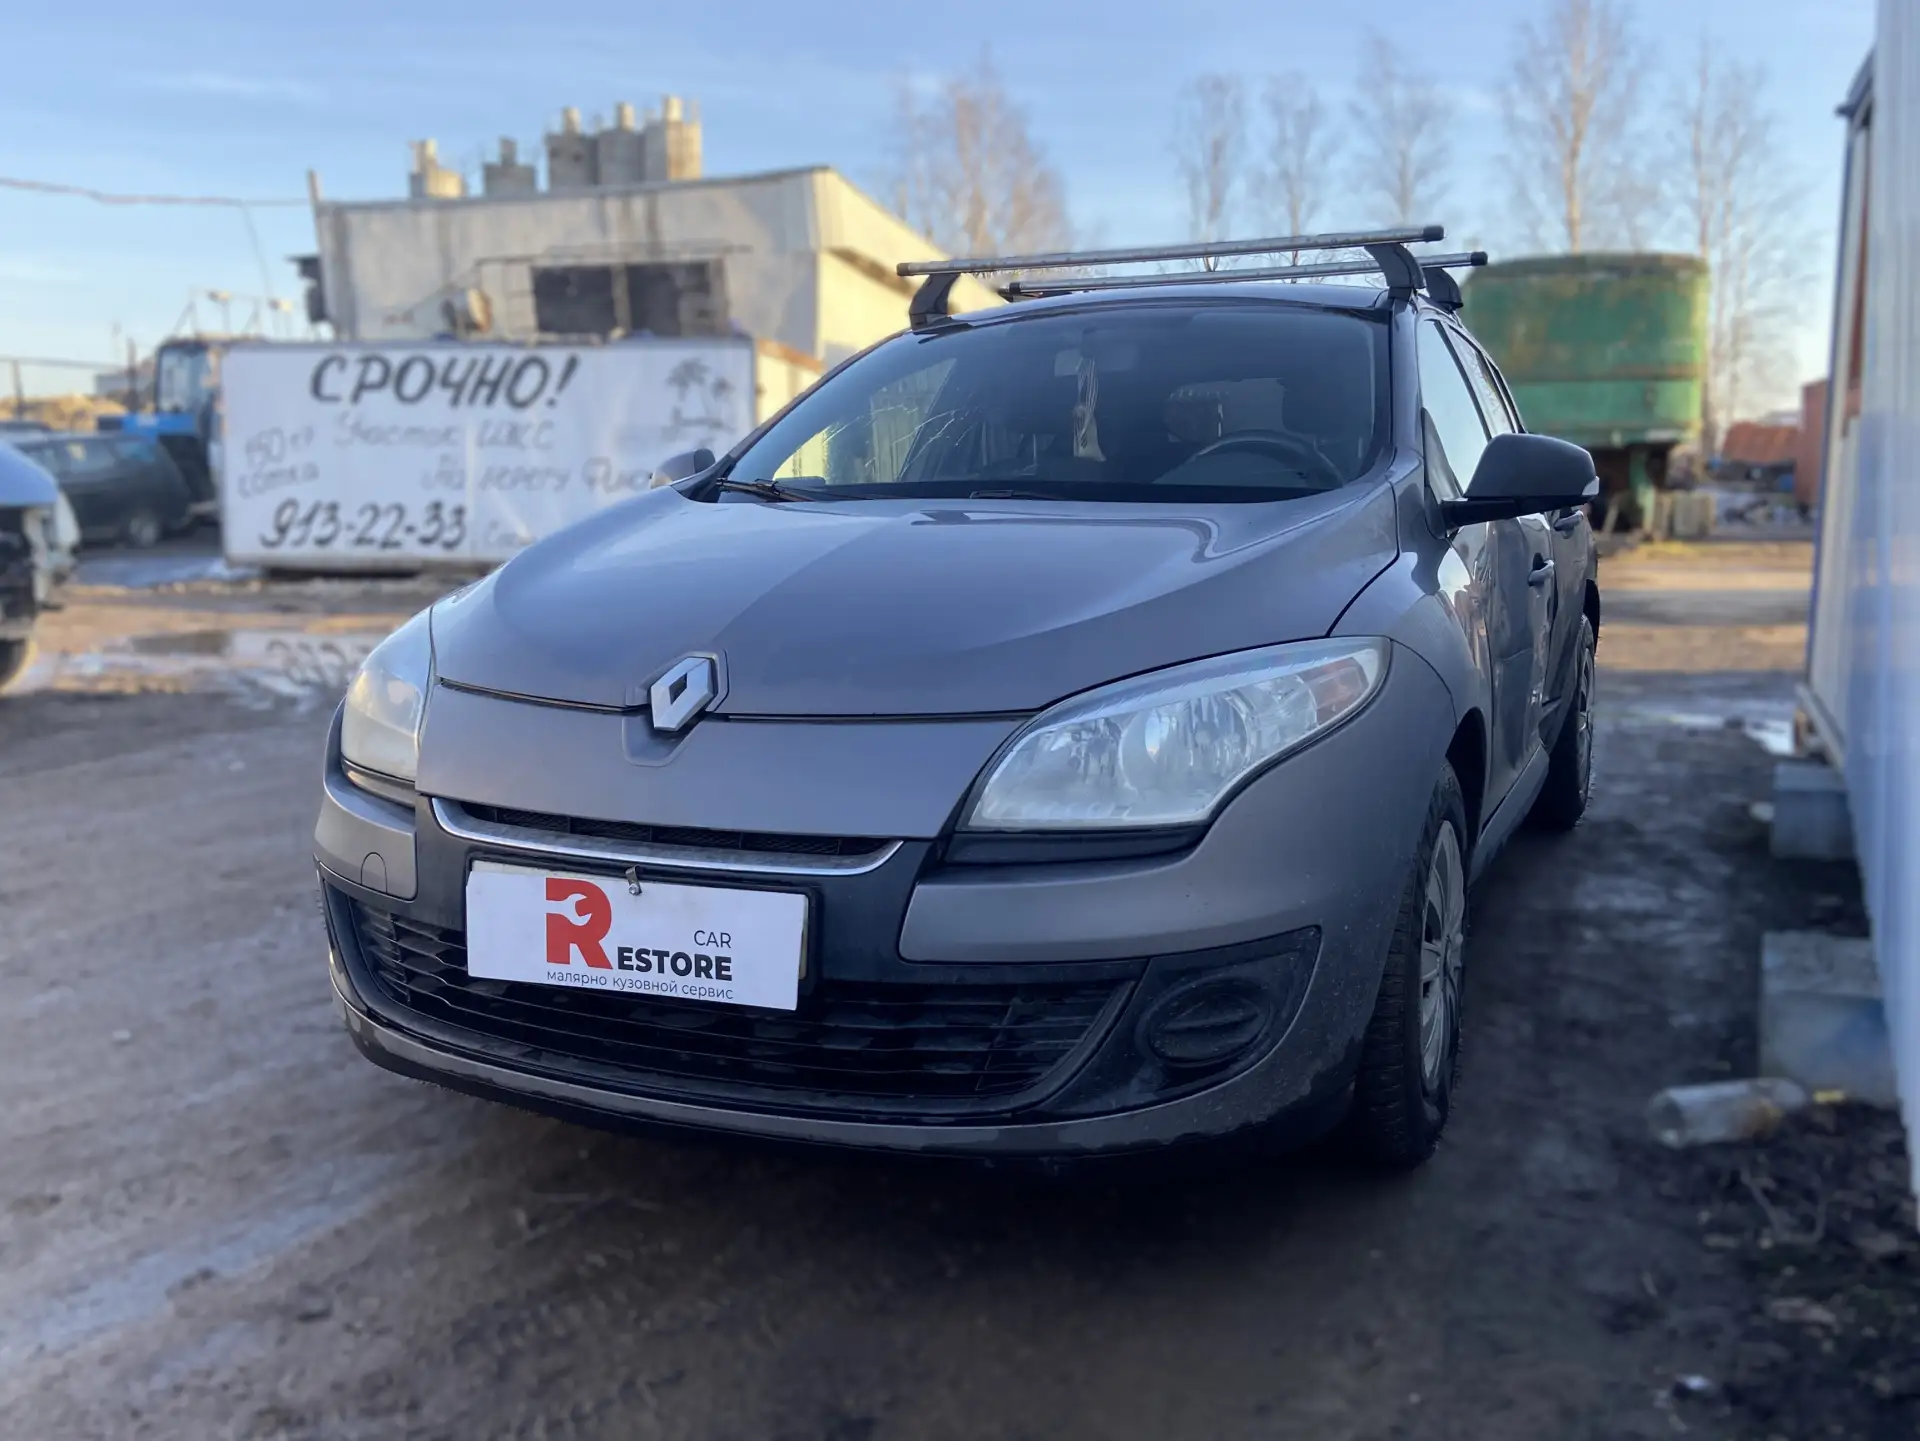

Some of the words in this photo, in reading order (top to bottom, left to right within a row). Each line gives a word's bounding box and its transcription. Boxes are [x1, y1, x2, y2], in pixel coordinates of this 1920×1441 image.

[310, 353, 580, 409] СРОЧНО!
[259, 497, 467, 551] 913-22-33
[693, 929, 732, 949] CAR
[546, 970, 608, 987] малярно
[612, 976, 679, 996] кузовной
[681, 983, 734, 1000] сервис
